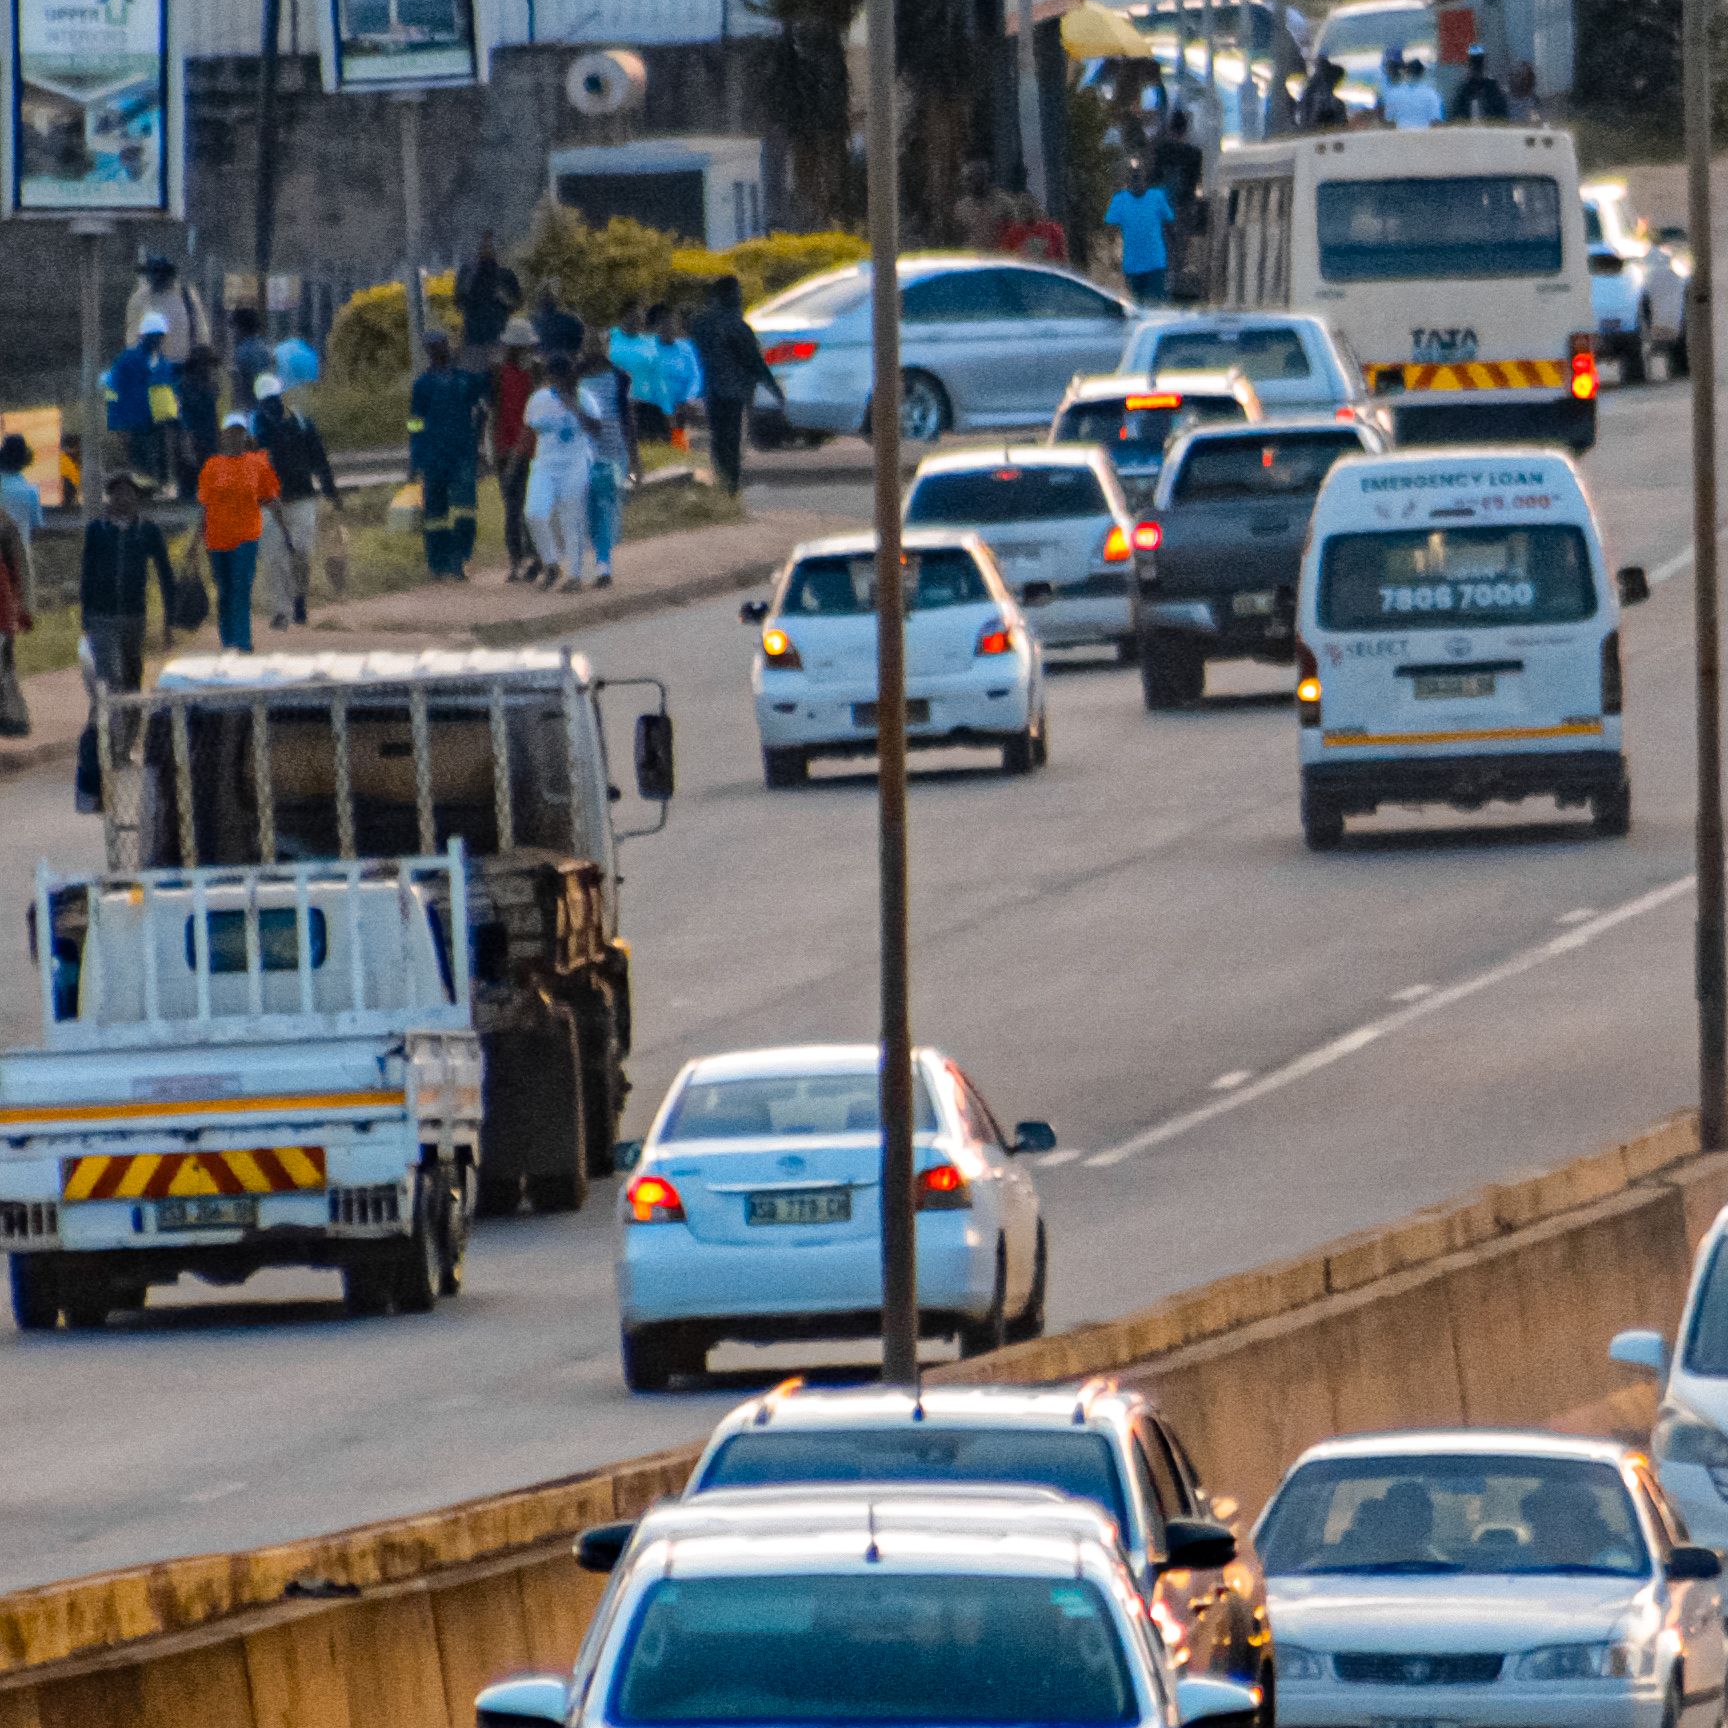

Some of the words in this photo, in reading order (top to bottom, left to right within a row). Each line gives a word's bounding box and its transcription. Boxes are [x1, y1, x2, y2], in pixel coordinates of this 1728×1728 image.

[1411, 328, 1478, 349] TATA
[1361, 473, 1480, 493] EMERGENCY
[1488, 471, 1544, 488] LOAN
[1457, 582, 1534, 610] 7000
